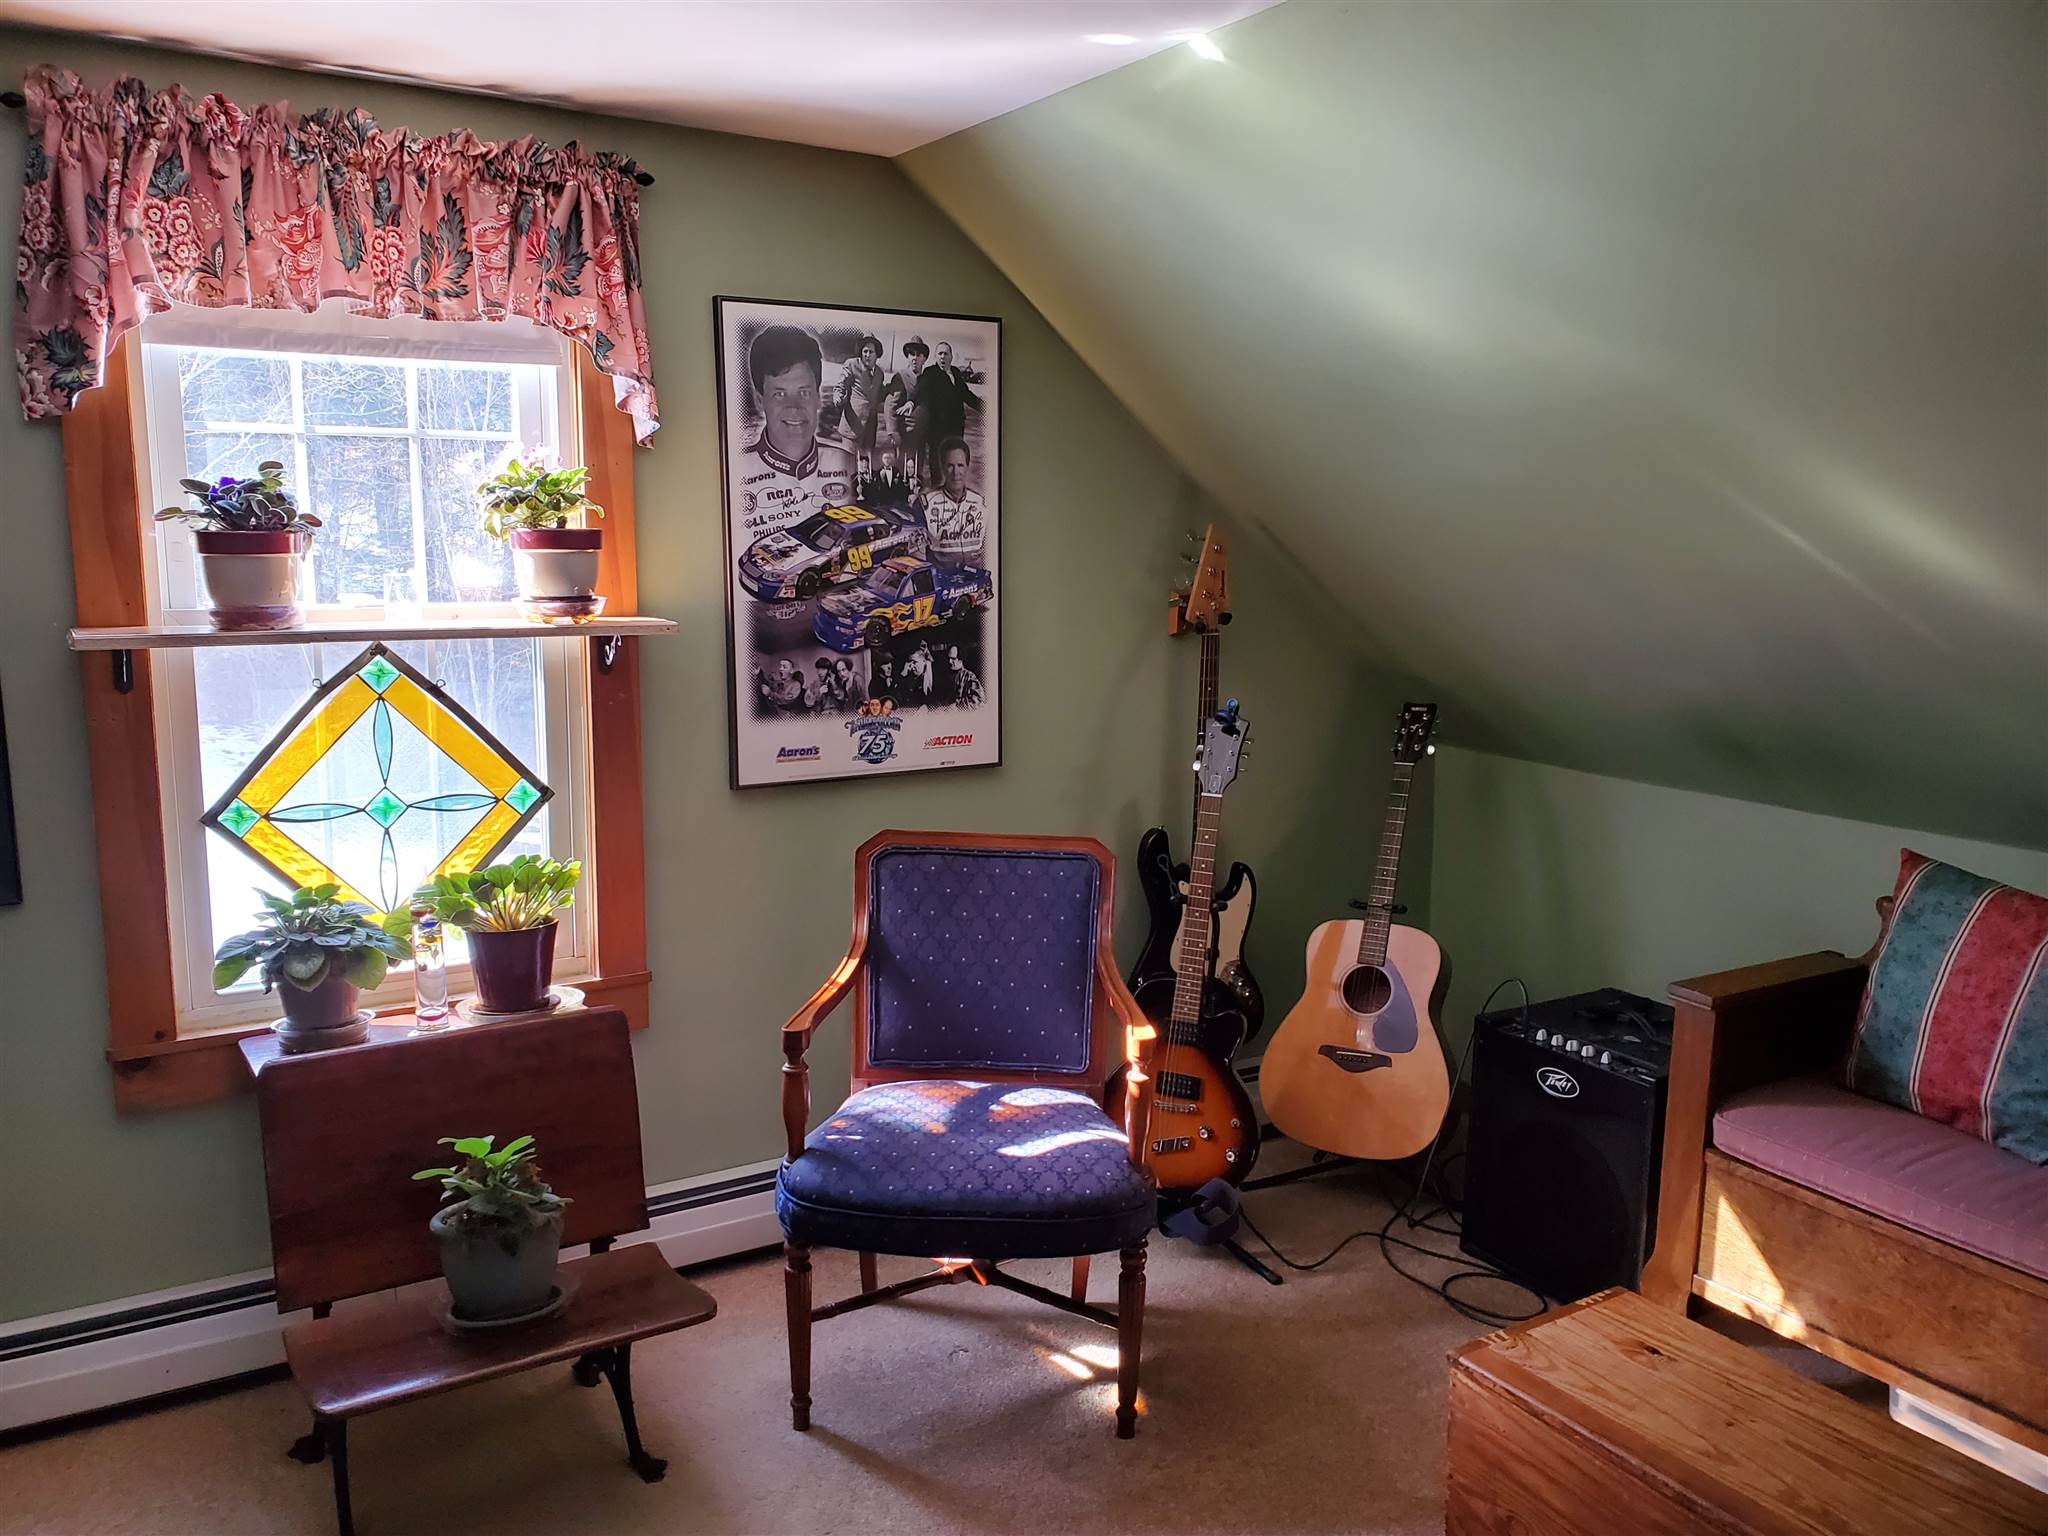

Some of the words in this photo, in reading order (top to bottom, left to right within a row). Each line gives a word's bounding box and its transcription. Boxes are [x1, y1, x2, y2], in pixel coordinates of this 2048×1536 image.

[766, 488, 794, 501] RCA
[768, 509, 801, 523] SONY
[824, 504, 877, 524] 99
[847, 544, 873, 572] 99
[912, 594, 936, 623] 17
[933, 734, 973, 746] ACTION
[776, 745, 821, 758] Aaron's
